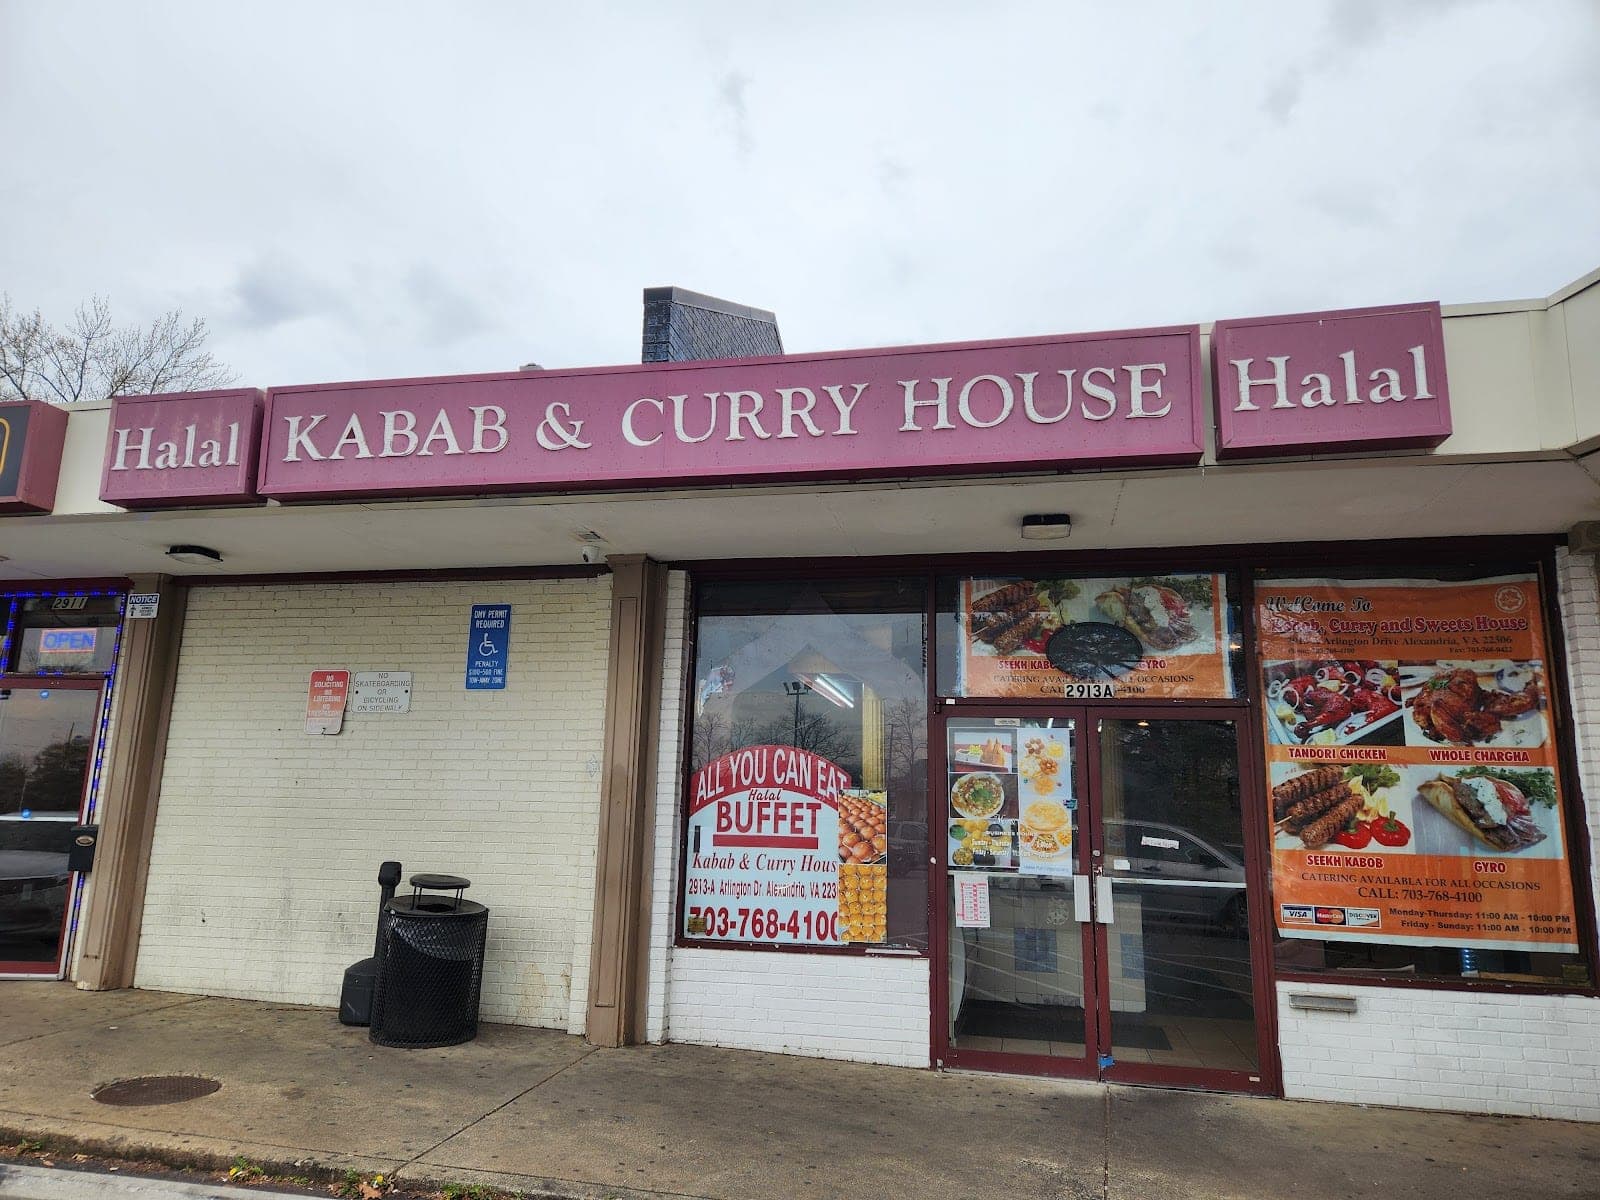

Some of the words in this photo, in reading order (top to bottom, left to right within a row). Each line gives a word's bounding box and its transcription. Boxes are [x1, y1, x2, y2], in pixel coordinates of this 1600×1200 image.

[1230, 344, 1438, 412] Halal
[282, 405, 510, 464] KABAB
[535, 401, 593, 451] &
[621, 382, 870, 448] CURRY
[897, 362, 1173, 433] HOUSE
[111, 422, 241, 472] Halal
[129, 595, 158, 604] NOTICE
[1350, 597, 1372, 612] To
[474, 610, 487, 619] DMV
[488, 609, 508, 618] PERMIT
[475, 620, 505, 629] REQUIRED
[1329, 618, 1378, 636] Curry
[1381, 617, 1412, 633] and
[1414, 617, 1474, 633] Sweets
[1475, 615, 1529, 631] House
[44, 631, 95, 650] OPEN
[1325, 637, 1369, 647] Arlington
[1372, 637, 1399, 646] Drive
[475, 660, 498, 668] PENALTY
[999, 660, 1028, 669] SEEKH
[1138, 660, 1167, 669] GYRO
[355, 680, 411, 688] SKATEBOARDING
[993, 675, 1040, 683] CATERING
[1137, 675, 1195, 683] OCCASIONS
[1065, 684, 1113, 698] 2913A
[363, 696, 399, 704] BICYCLING
[369, 704, 403, 712] SIDEWALK
[1288, 747, 1337, 760] TANDORI
[1339, 748, 1387, 761] CHICKEN
[1430, 750, 1471, 762] WHOLE
[1474, 750, 1530, 762] CHARGHA
[696, 761, 726, 806] ALL
[729, 749, 767, 789] YOU
[773, 748, 812, 790] CAN
[817, 761, 847, 803] EAT
[748, 788, 782, 801] Halal
[716, 800, 822, 835] BUFFET
[692, 852, 734, 870] Kabab
[739, 853, 750, 870] &
[756, 853, 796, 875] Curry
[800, 854, 838, 873] Hous
[1306, 854, 1343, 867] SEEKH
[1344, 856, 1384, 869] KABOB
[1474, 861, 1507, 873] GYRO
[1301, 872, 1357, 883] CATERING
[1360, 874, 1424, 886] AVAILABLA
[1425, 877, 1448, 887] FOR
[1450, 879, 1472, 889] ALL
[1474, 880, 1541, 891] OCCASIONS
[688, 878, 715, 896] 2913-A
[719, 879, 752, 900] Arlington
[766, 881, 807, 900] Alexandria,
[809, 883, 820, 898] VA
[822, 882, 837, 899] 223
[1358, 886, 1399, 899] CALL:
[1402, 888, 1483, 903] 703-768-4100
[1289, 910, 1308, 918] VISA
[1389, 907, 1474, 920] Monday-Thursday:
[1476, 911, 1501, 921] 11:00
[1503, 913, 1519, 921] AM
[1527, 914, 1553, 922] 10:00
[1555, 915, 1571, 923] PM
[1400, 919, 1430, 930] Friday
[1438, 921, 1475, 932] Sunday:
[1477, 923, 1502, 932] 11:00
[1504, 925, 1521, 933] AM
[1529, 926, 1555, 935] 10:00
[1557, 927, 1572, 935] PM
